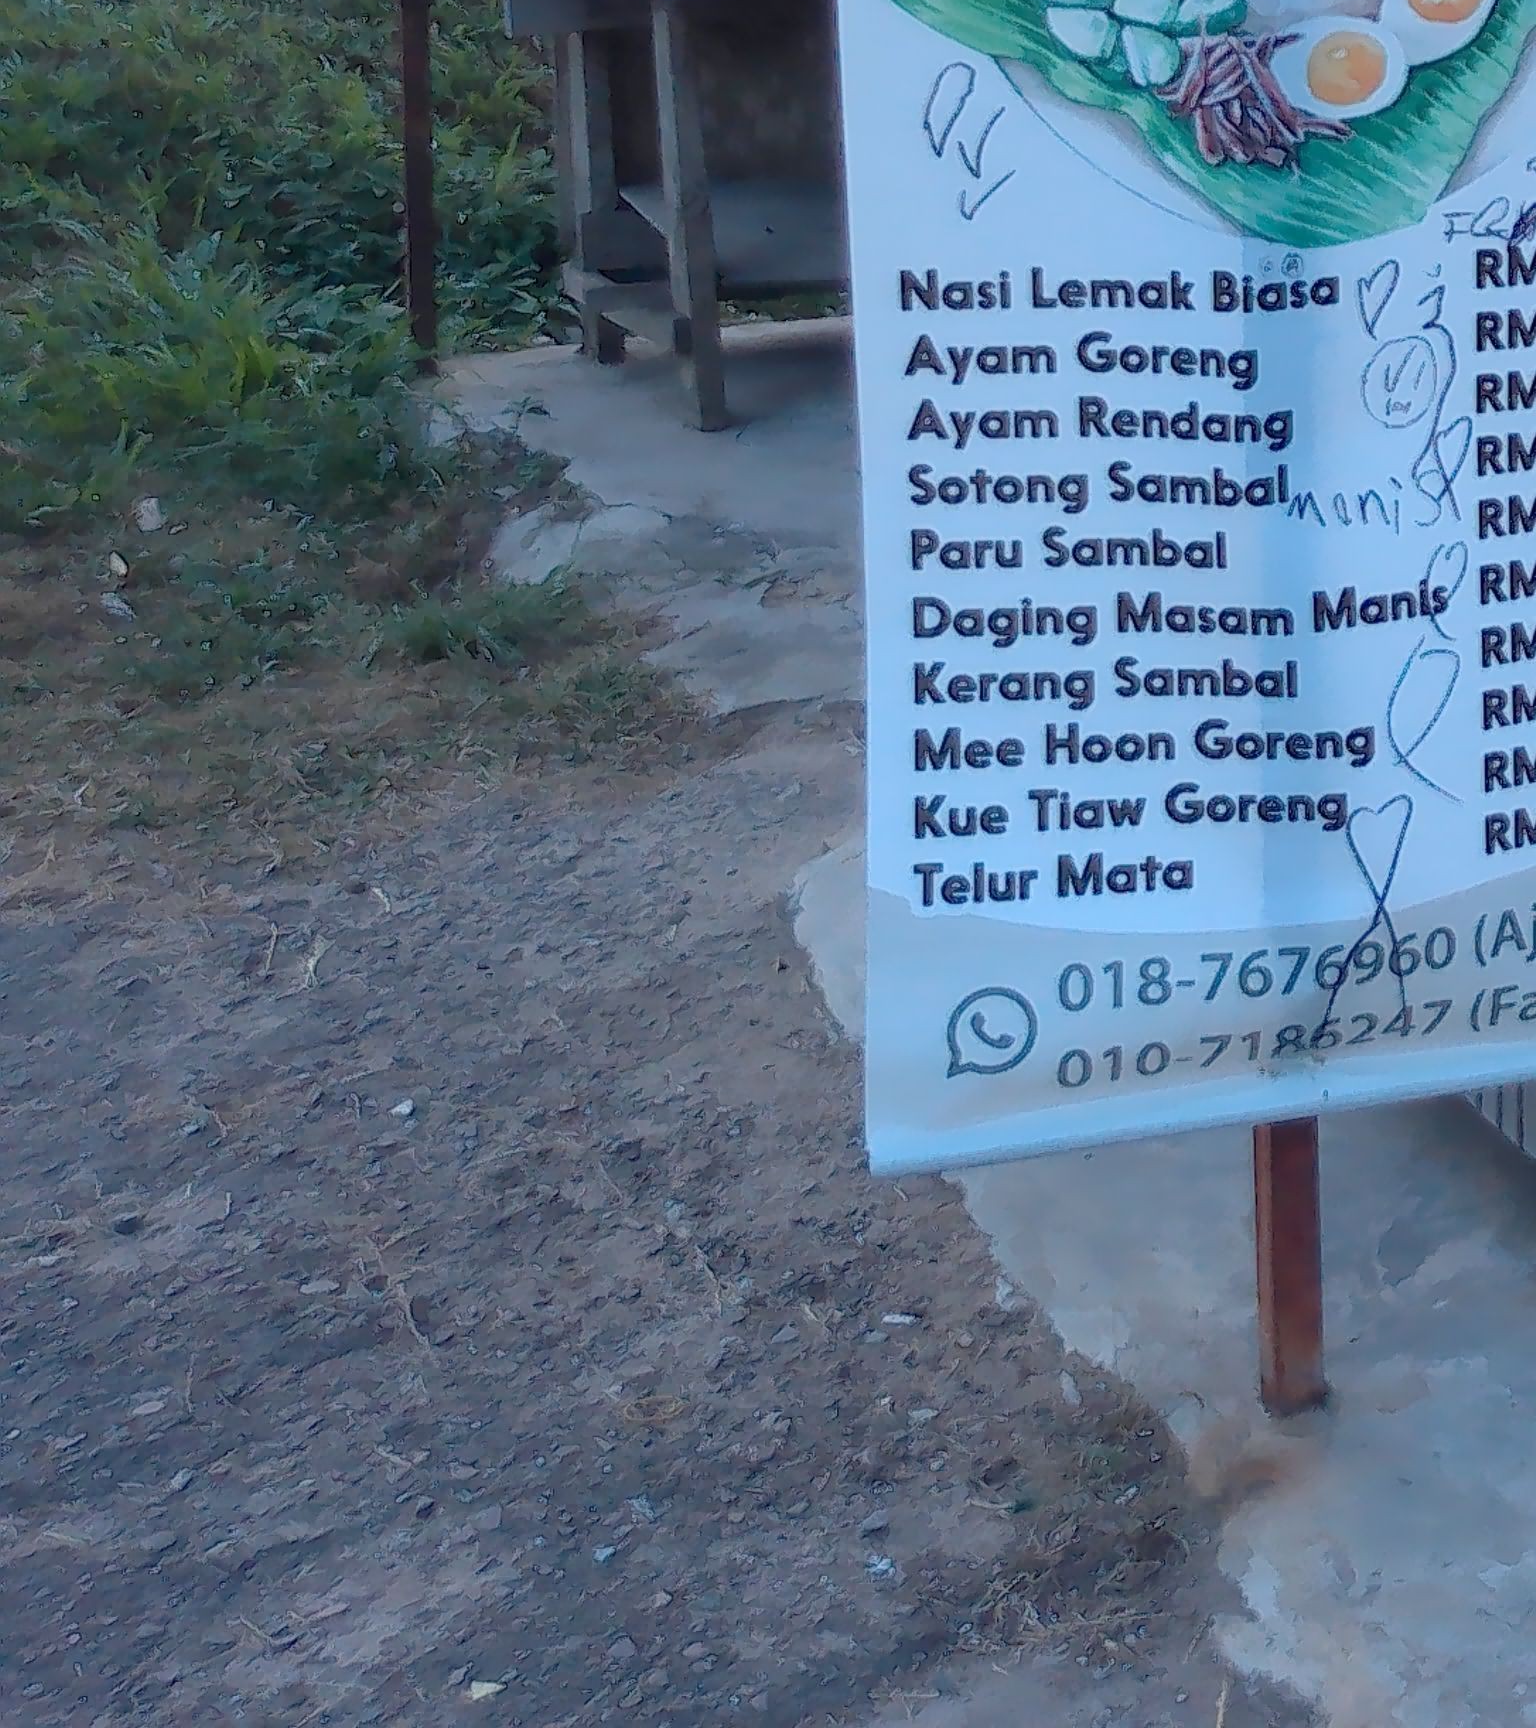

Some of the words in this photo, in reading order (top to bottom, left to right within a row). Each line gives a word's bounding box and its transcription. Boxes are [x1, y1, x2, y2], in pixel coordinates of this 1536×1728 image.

[900, 266, 1012, 312] Nasi
[1031, 266, 1196, 311] Lemak
[1212, 270, 1340, 313] Biasa
[905, 333, 1057, 385] Ayam
[1076, 331, 1259, 391] Goreng
[907, 397, 1060, 449] Ayam
[1078, 396, 1294, 452] Rendang
[908, 463, 1088, 514] Sotong
[1108, 460, 1290, 507] Sambal
[910, 528, 1023, 570] Paru
[1042, 526, 1228, 570] Sambal
[913, 595, 1098, 648] Daging
[1116, 591, 1294, 637] Masam
[1312, 578, 1449, 634] Manis
[913, 661, 1096, 710] Kerang
[1114, 655, 1299, 699] Sambal
[913, 726, 1026, 771] Mee
[1045, 721, 1176, 765] Hoon
[1194, 718, 1376, 768] Goreng
[913, 794, 1009, 839] Kue
[1028, 787, 1147, 833] Tiaw
[1164, 781, 1348, 833] Goreng
[913, 861, 1039, 908] Telur
[1057, 851, 1194, 899] Mata
[1056, 925, 1458, 1013] 018-7676960
[1056, 999, 1453, 1089] 010-7186247
